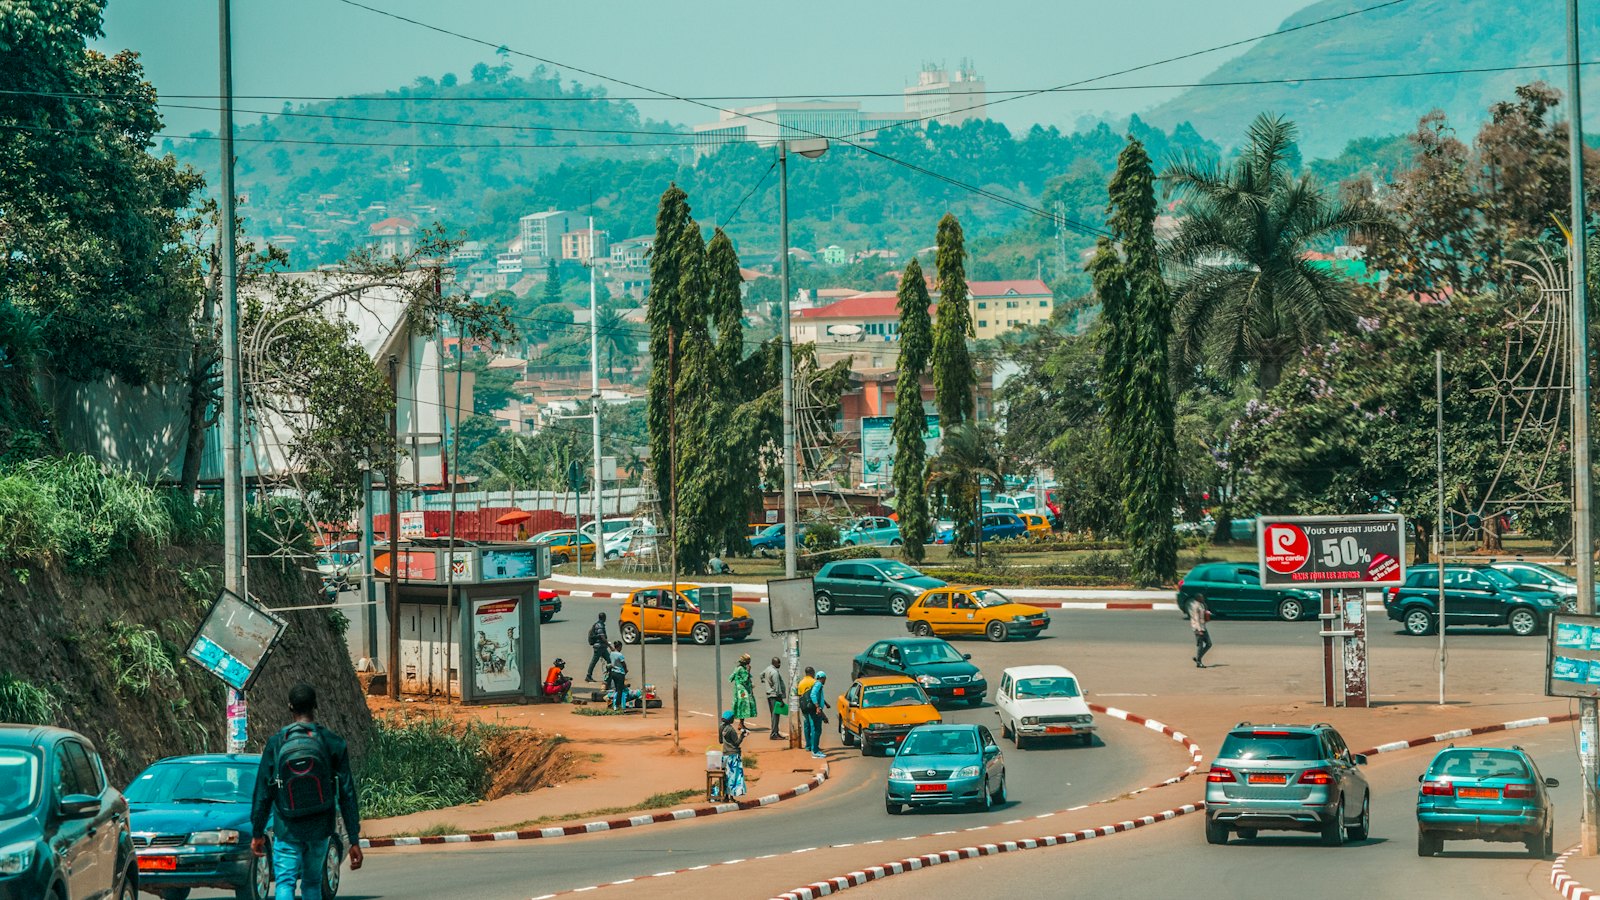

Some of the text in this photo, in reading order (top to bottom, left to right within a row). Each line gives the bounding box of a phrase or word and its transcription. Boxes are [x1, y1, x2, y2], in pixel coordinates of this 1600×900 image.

[1329, 526, 1362, 535] OFFRENT
[1266, 555, 1285, 563] pierre
[1309, 571, 1325, 580] TOUS
[1326, 571, 1336, 580] LES
